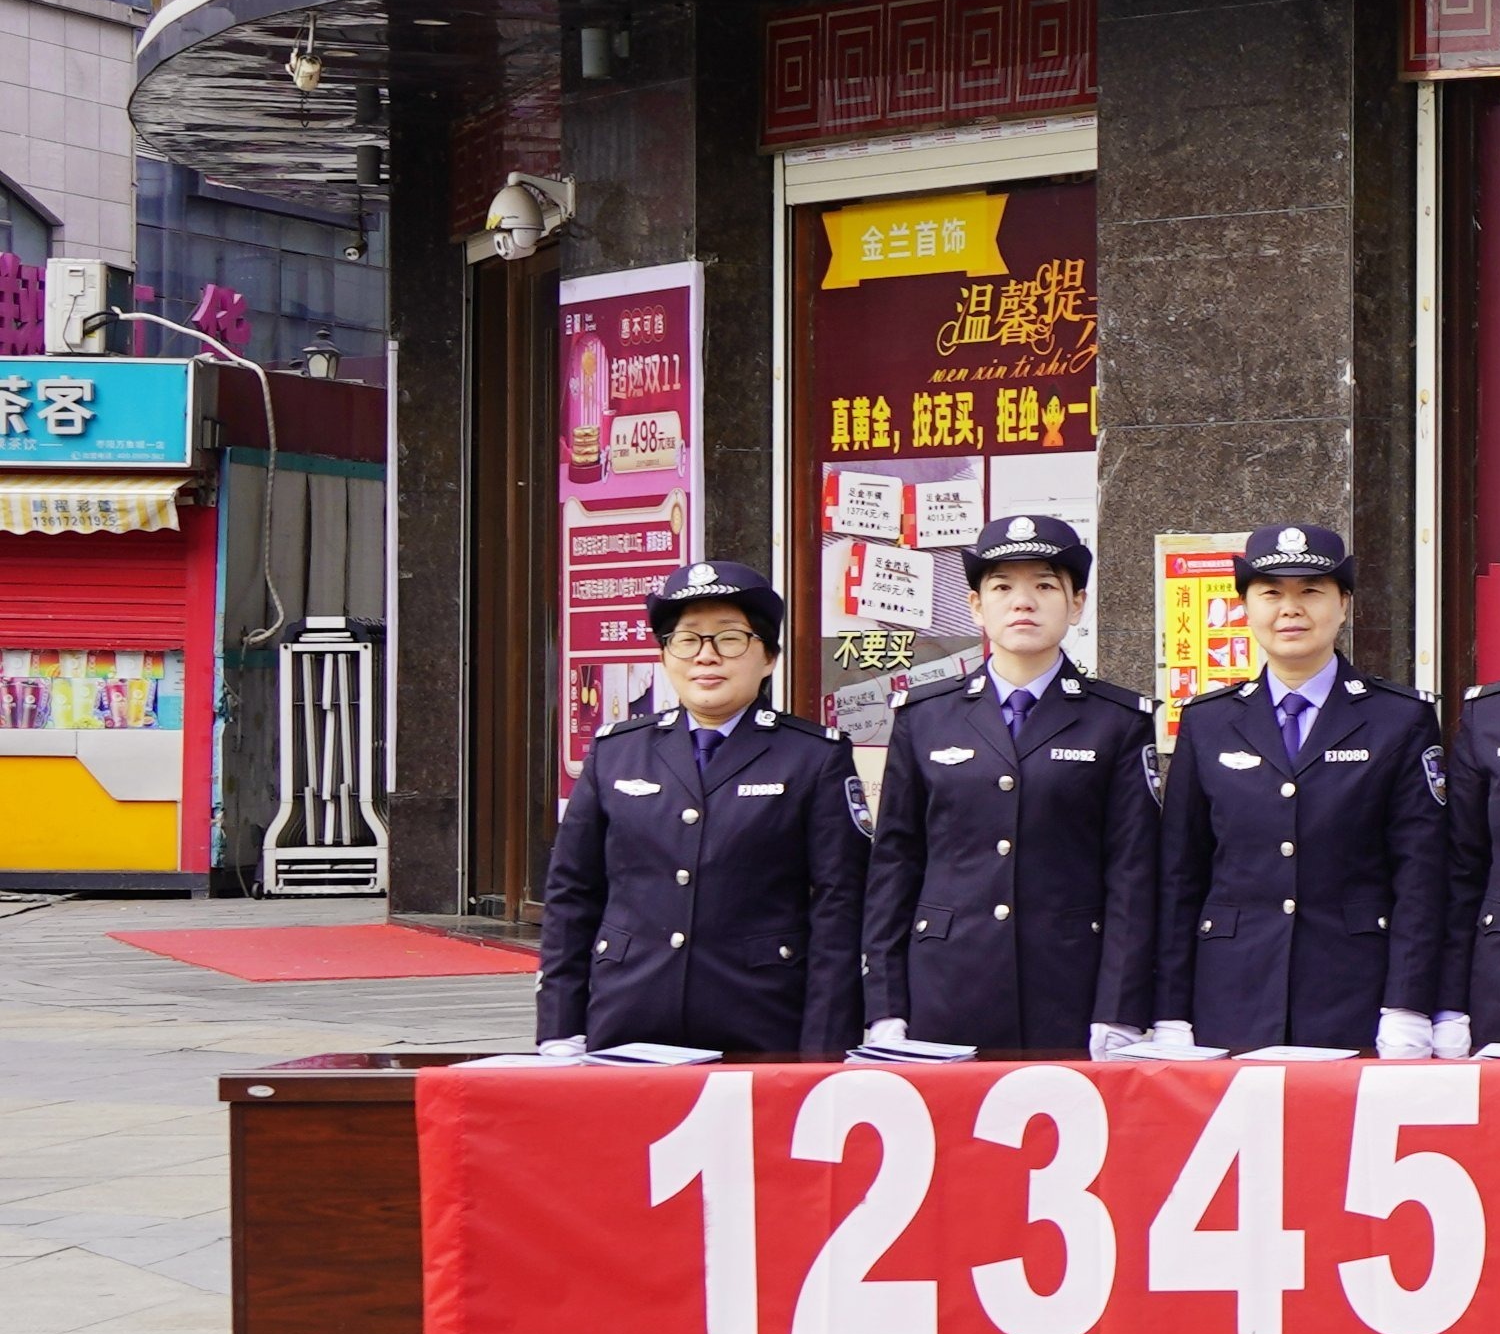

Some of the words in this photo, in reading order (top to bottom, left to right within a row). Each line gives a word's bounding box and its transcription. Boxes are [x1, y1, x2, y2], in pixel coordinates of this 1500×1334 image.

[861, 218, 966, 262] 金兰首饰
[1175, 584, 1192, 662] 消火栓
[833, 630, 916, 670] 不要买
